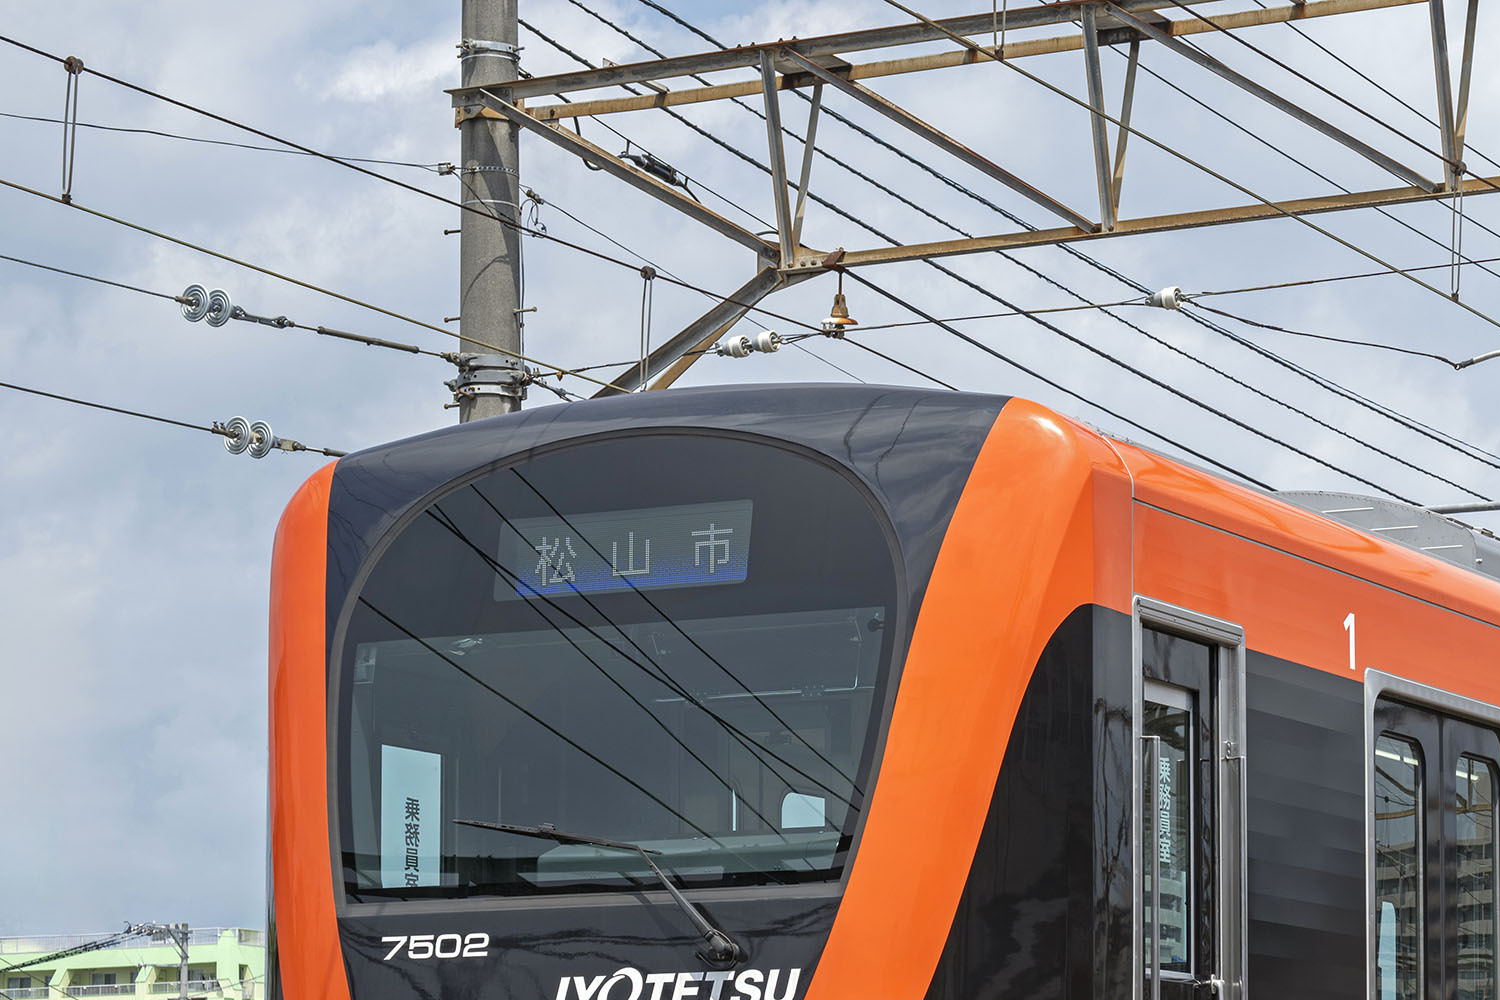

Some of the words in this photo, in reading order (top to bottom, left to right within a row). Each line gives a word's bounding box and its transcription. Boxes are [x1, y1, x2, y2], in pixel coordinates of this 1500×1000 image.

[534, 513, 734, 587] 松山市
[1343, 612, 1356, 671] 1
[1159, 757, 1171, 863] 乗務員室
[380, 933, 489, 960] 7502
